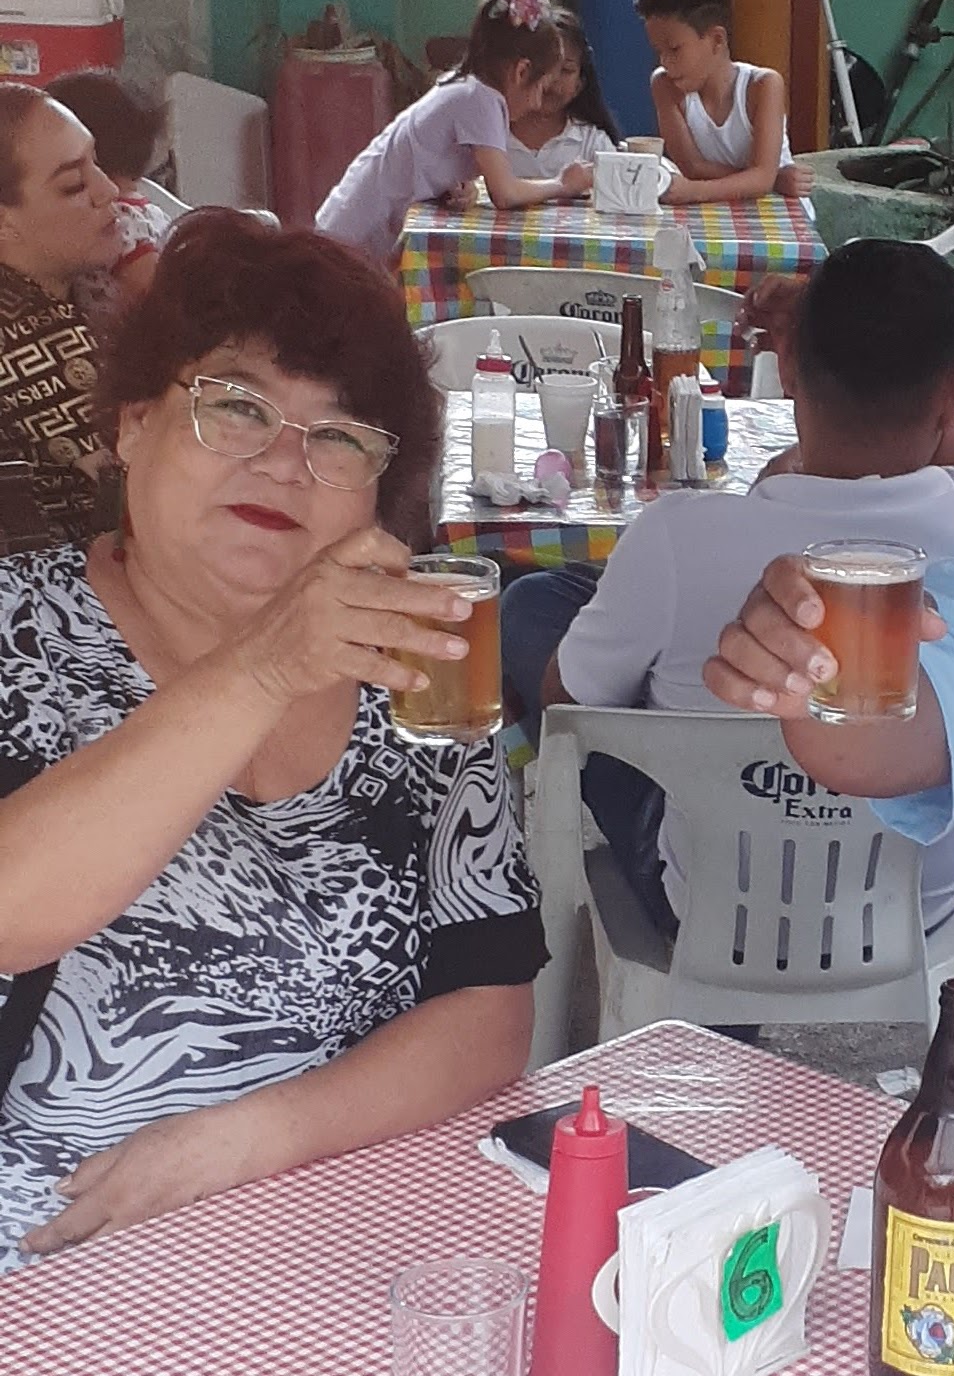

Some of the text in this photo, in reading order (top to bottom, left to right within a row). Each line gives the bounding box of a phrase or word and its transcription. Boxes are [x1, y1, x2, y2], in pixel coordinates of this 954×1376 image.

[626, 162, 643, 185] 4
[559, 301, 623, 324] Coron
[784, 798, 852, 819] Extra
[729, 1226, 774, 1322] 6
